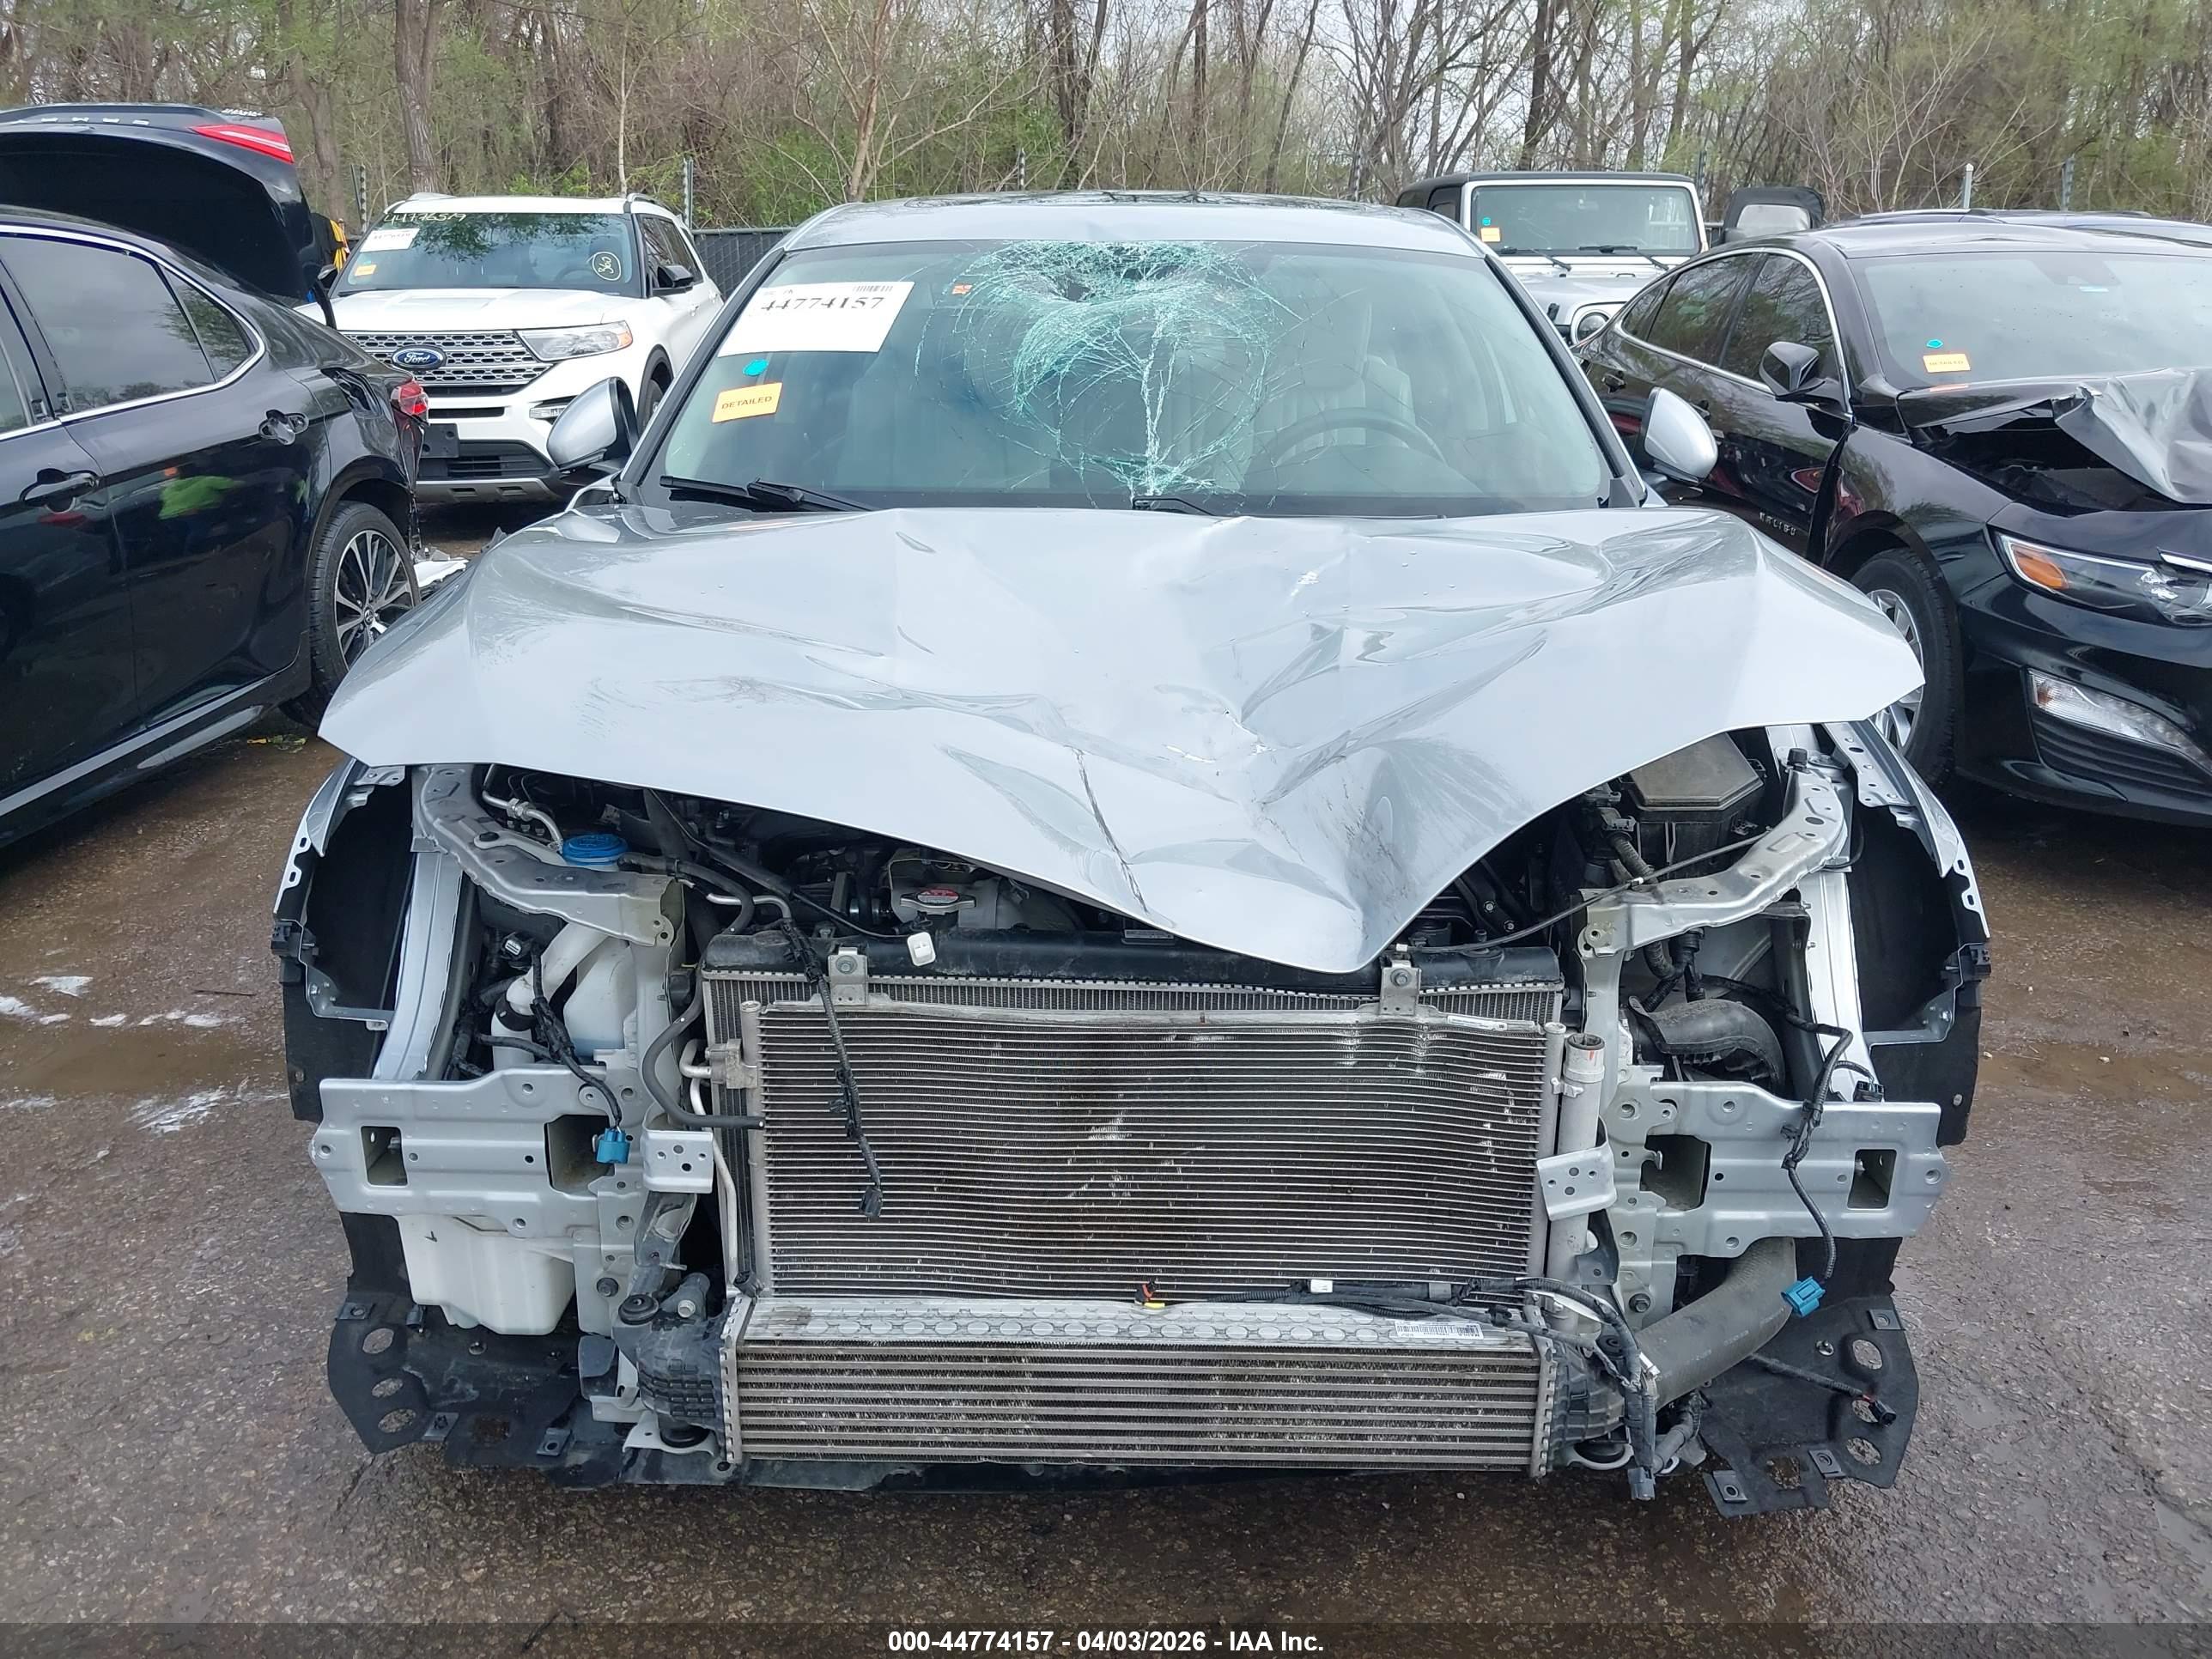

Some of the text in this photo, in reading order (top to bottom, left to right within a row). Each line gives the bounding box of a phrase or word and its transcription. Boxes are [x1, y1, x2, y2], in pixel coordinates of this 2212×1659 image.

[761, 296, 884, 311] 44774157
[404, 351, 431, 364] Ford
[721, 395, 773, 410] DETAILED
